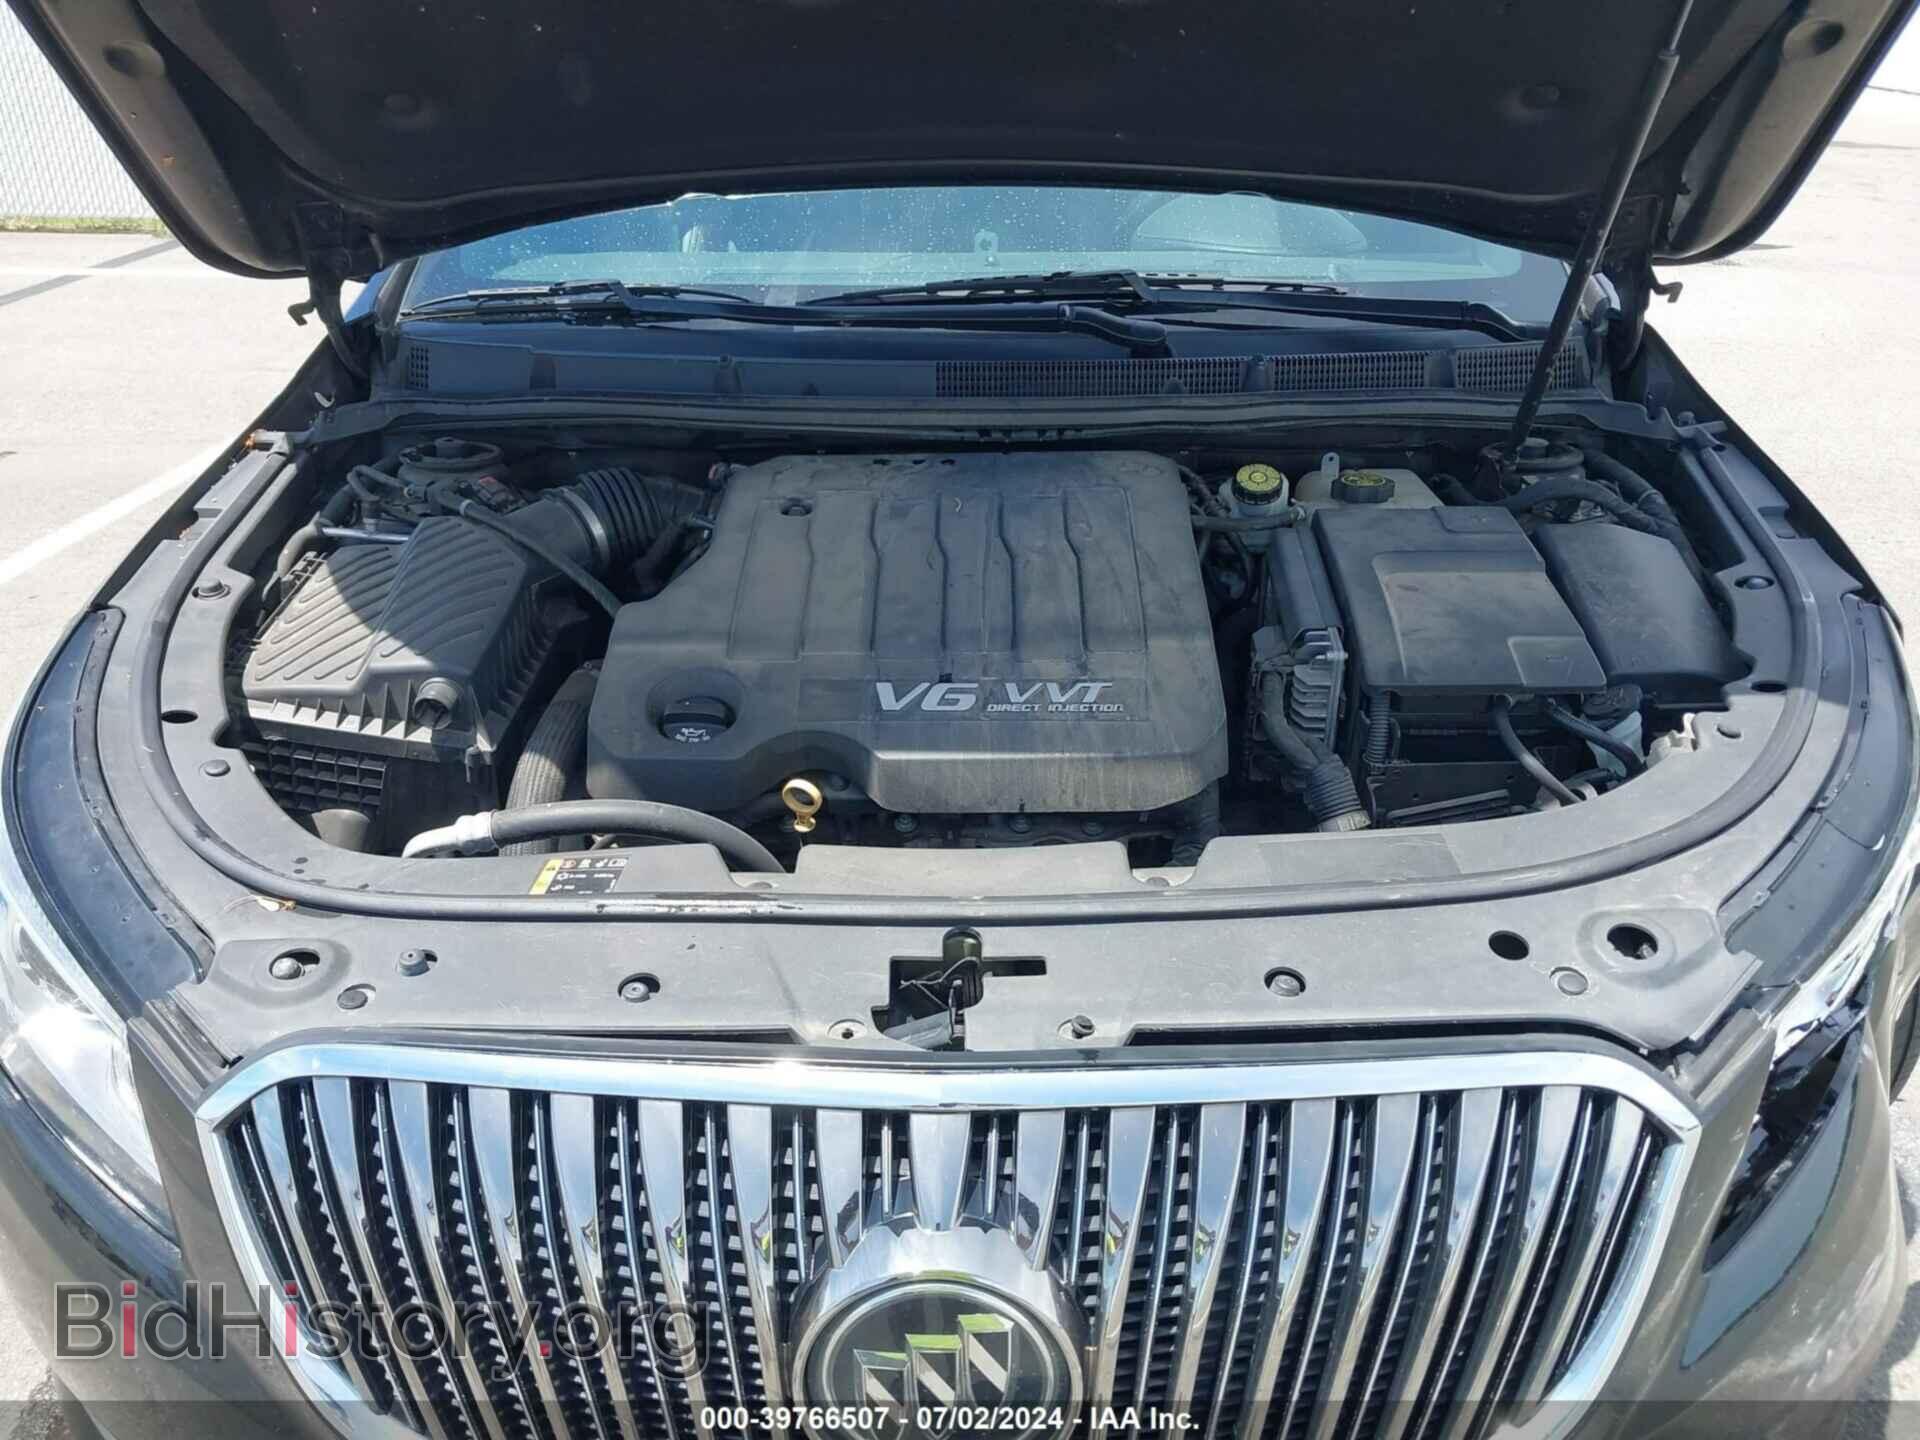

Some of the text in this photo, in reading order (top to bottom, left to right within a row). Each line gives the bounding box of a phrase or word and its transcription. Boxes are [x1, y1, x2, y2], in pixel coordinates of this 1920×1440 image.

[875, 682, 1113, 711] V6 VVT
[987, 703, 1041, 712] DIRECT
